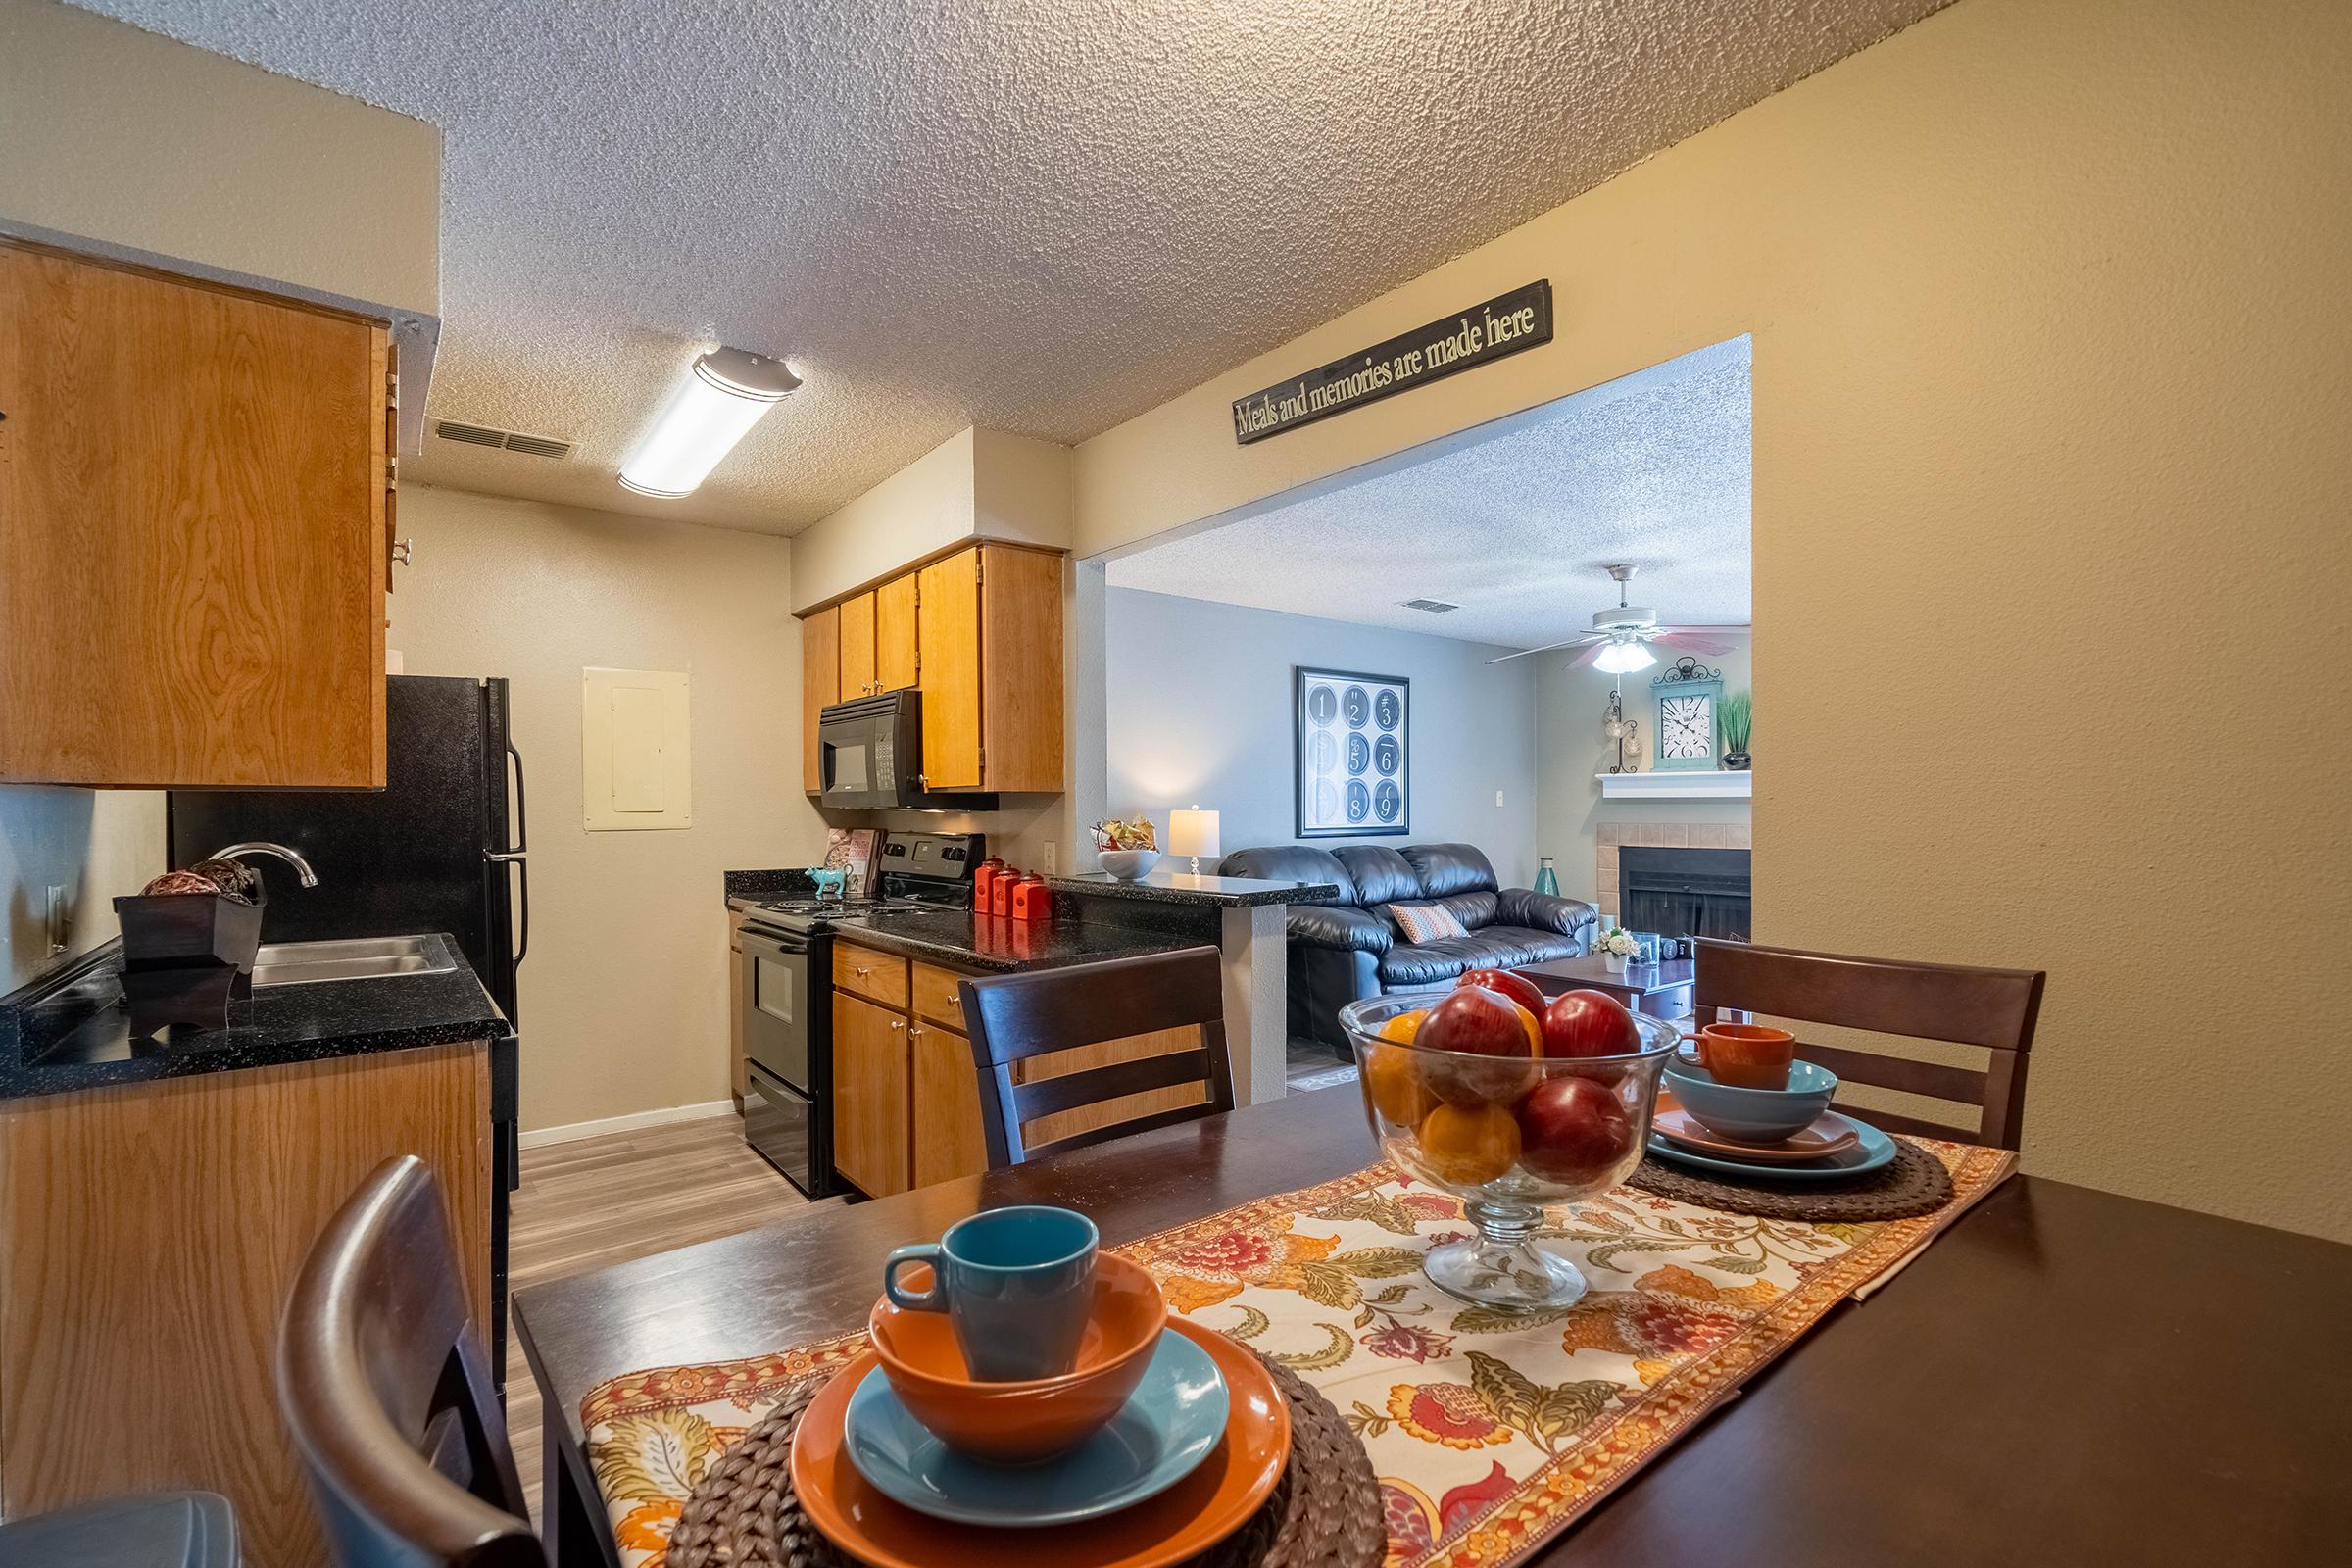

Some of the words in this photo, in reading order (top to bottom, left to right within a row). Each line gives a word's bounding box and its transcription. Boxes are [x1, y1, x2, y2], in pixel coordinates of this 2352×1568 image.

[1235, 394, 1279, 435] Meals
[1279, 381, 1308, 422] and
[1309, 359, 1393, 412] memories
[1394, 349, 1422, 381] are
[1425, 318, 1482, 369] made
[1483, 306, 1535, 348] here
[1319, 694, 1325, 717] 1
[1349, 704, 1359, 722] 2
[1382, 708, 1391, 725] 3
[1681, 695, 1693, 710] 12
[1681, 745, 1693, 758] 6
[1349, 752, 1359, 770] 5
[1382, 752, 1392, 771] 6
[1350, 799, 1361, 817] 8
[1381, 799, 1391, 817] 9
